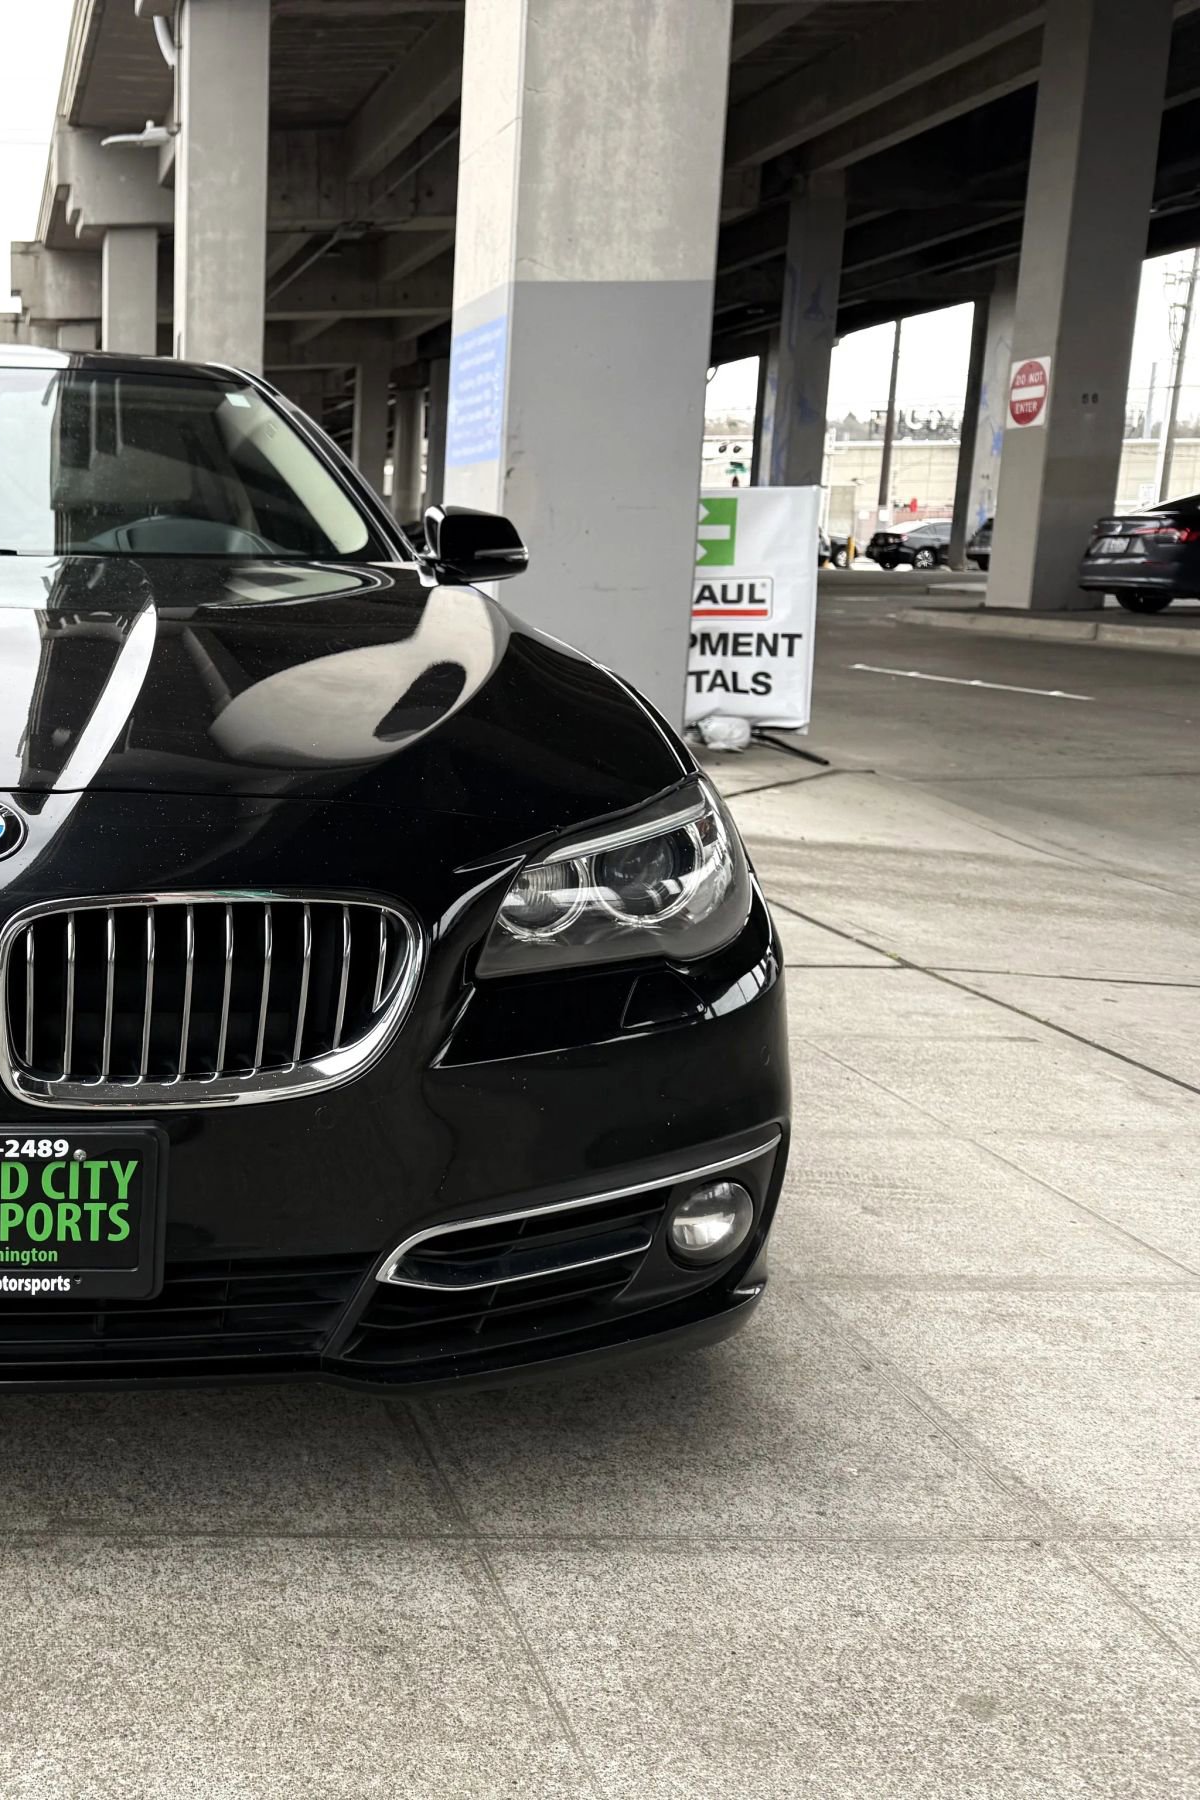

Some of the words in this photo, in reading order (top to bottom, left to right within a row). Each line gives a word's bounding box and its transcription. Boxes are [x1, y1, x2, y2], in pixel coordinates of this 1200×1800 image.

[1015, 374, 1026, 386] DO
[1029, 371, 1043, 384] NOT
[1015, 400, 1038, 415] ENTER
[694, 583, 766, 605] AUL
[687, 669, 772, 696] TALS
[41, 1160, 139, 1200] CITY
